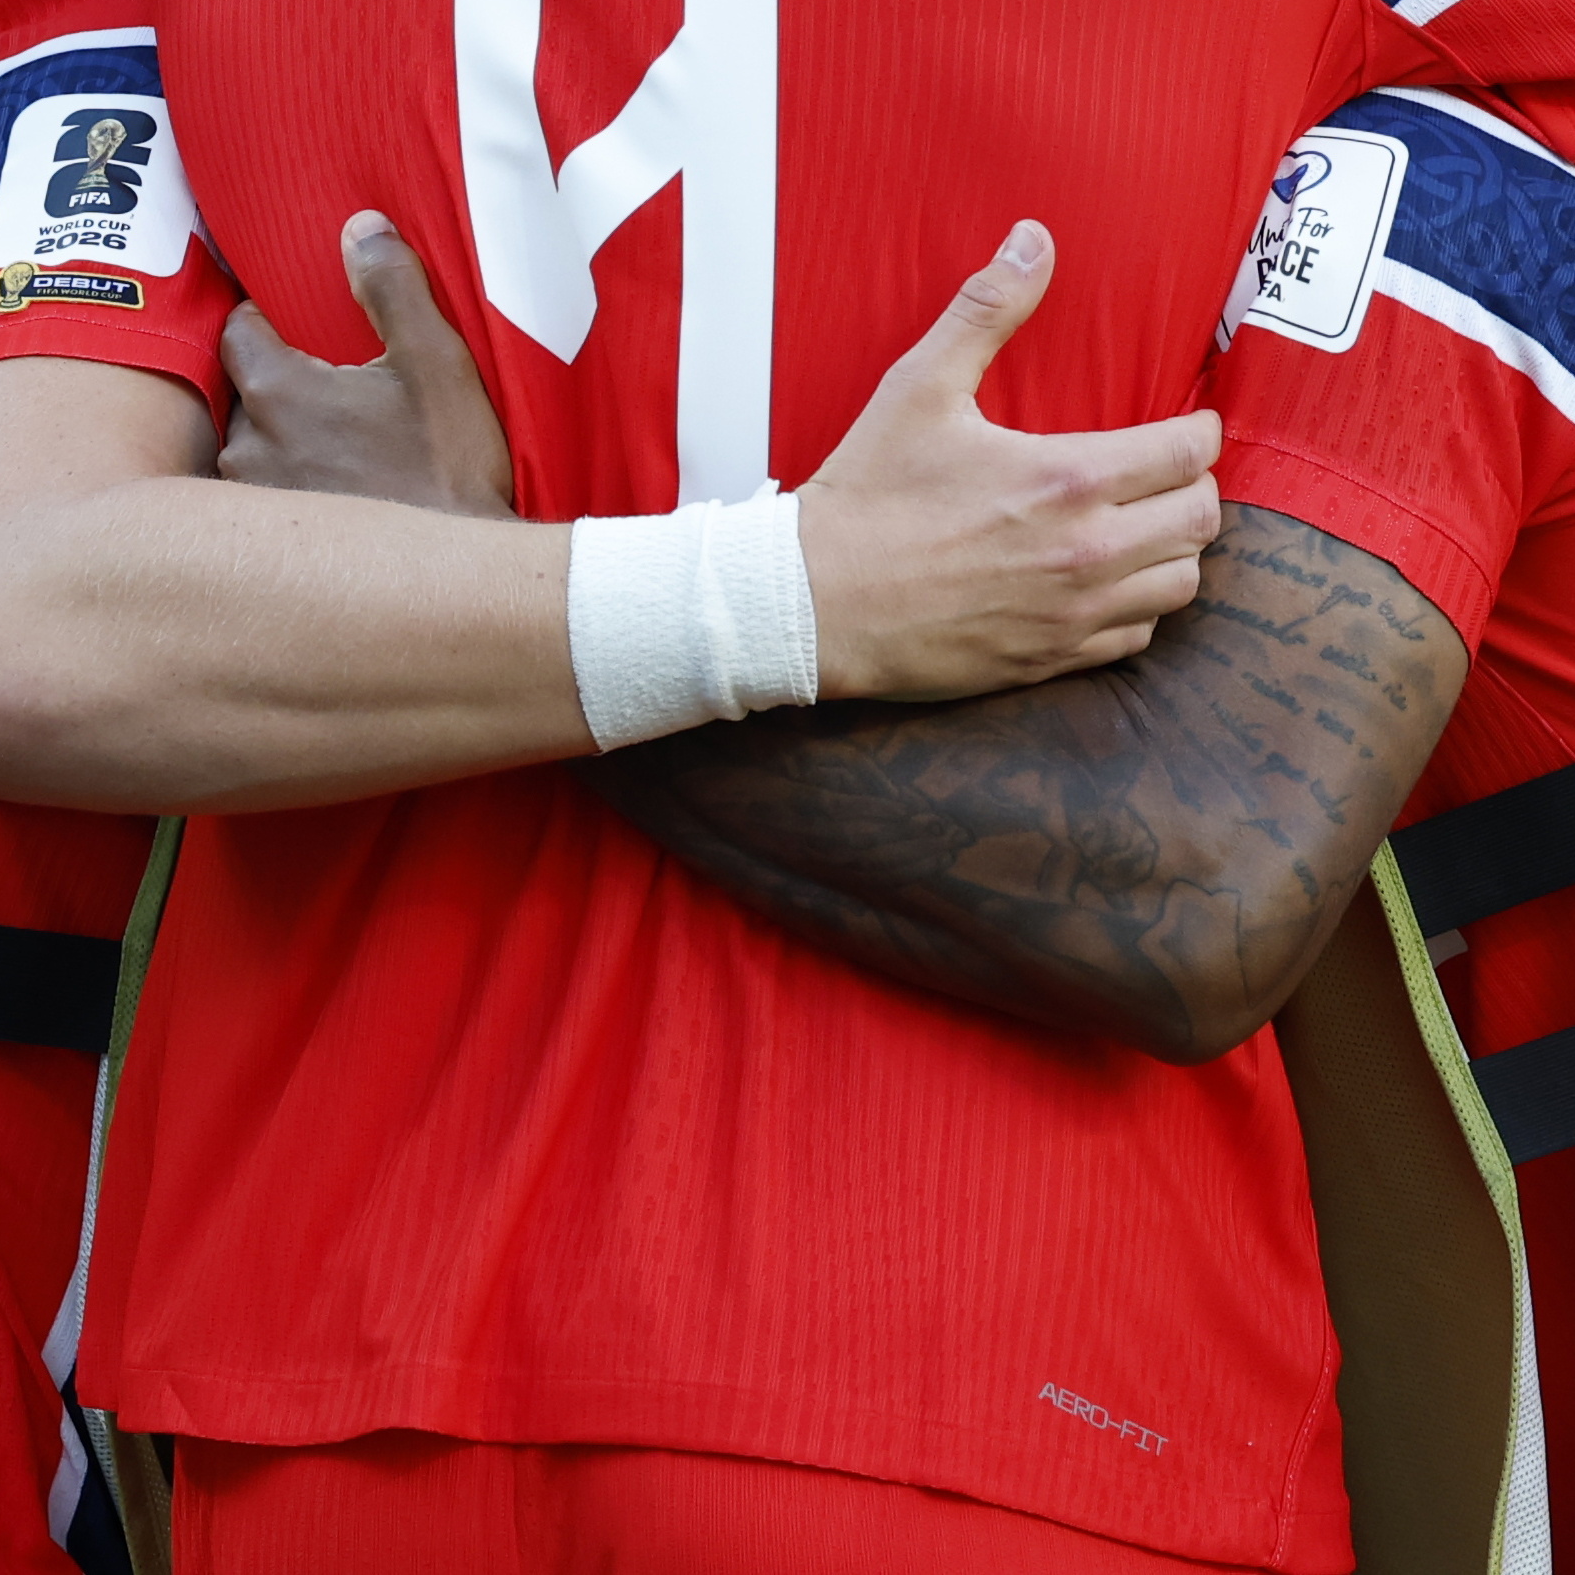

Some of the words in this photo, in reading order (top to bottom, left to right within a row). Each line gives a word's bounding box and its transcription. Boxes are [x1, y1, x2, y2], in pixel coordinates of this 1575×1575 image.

[68, 191, 112, 208] FIFA
[38, 218, 95, 237] WORLD
[97, 219, 132, 232] CUP
[1297, 207, 1335, 239] For
[33, 231, 128, 255] 2026
[32, 276, 131, 293] DEBUT
[36, 288, 59, 296] FIFA
[60, 288, 99, 298] WORLD
[100, 291, 123, 300] CUP
[1037, 1381, 1169, 1456] AERO-FIT
